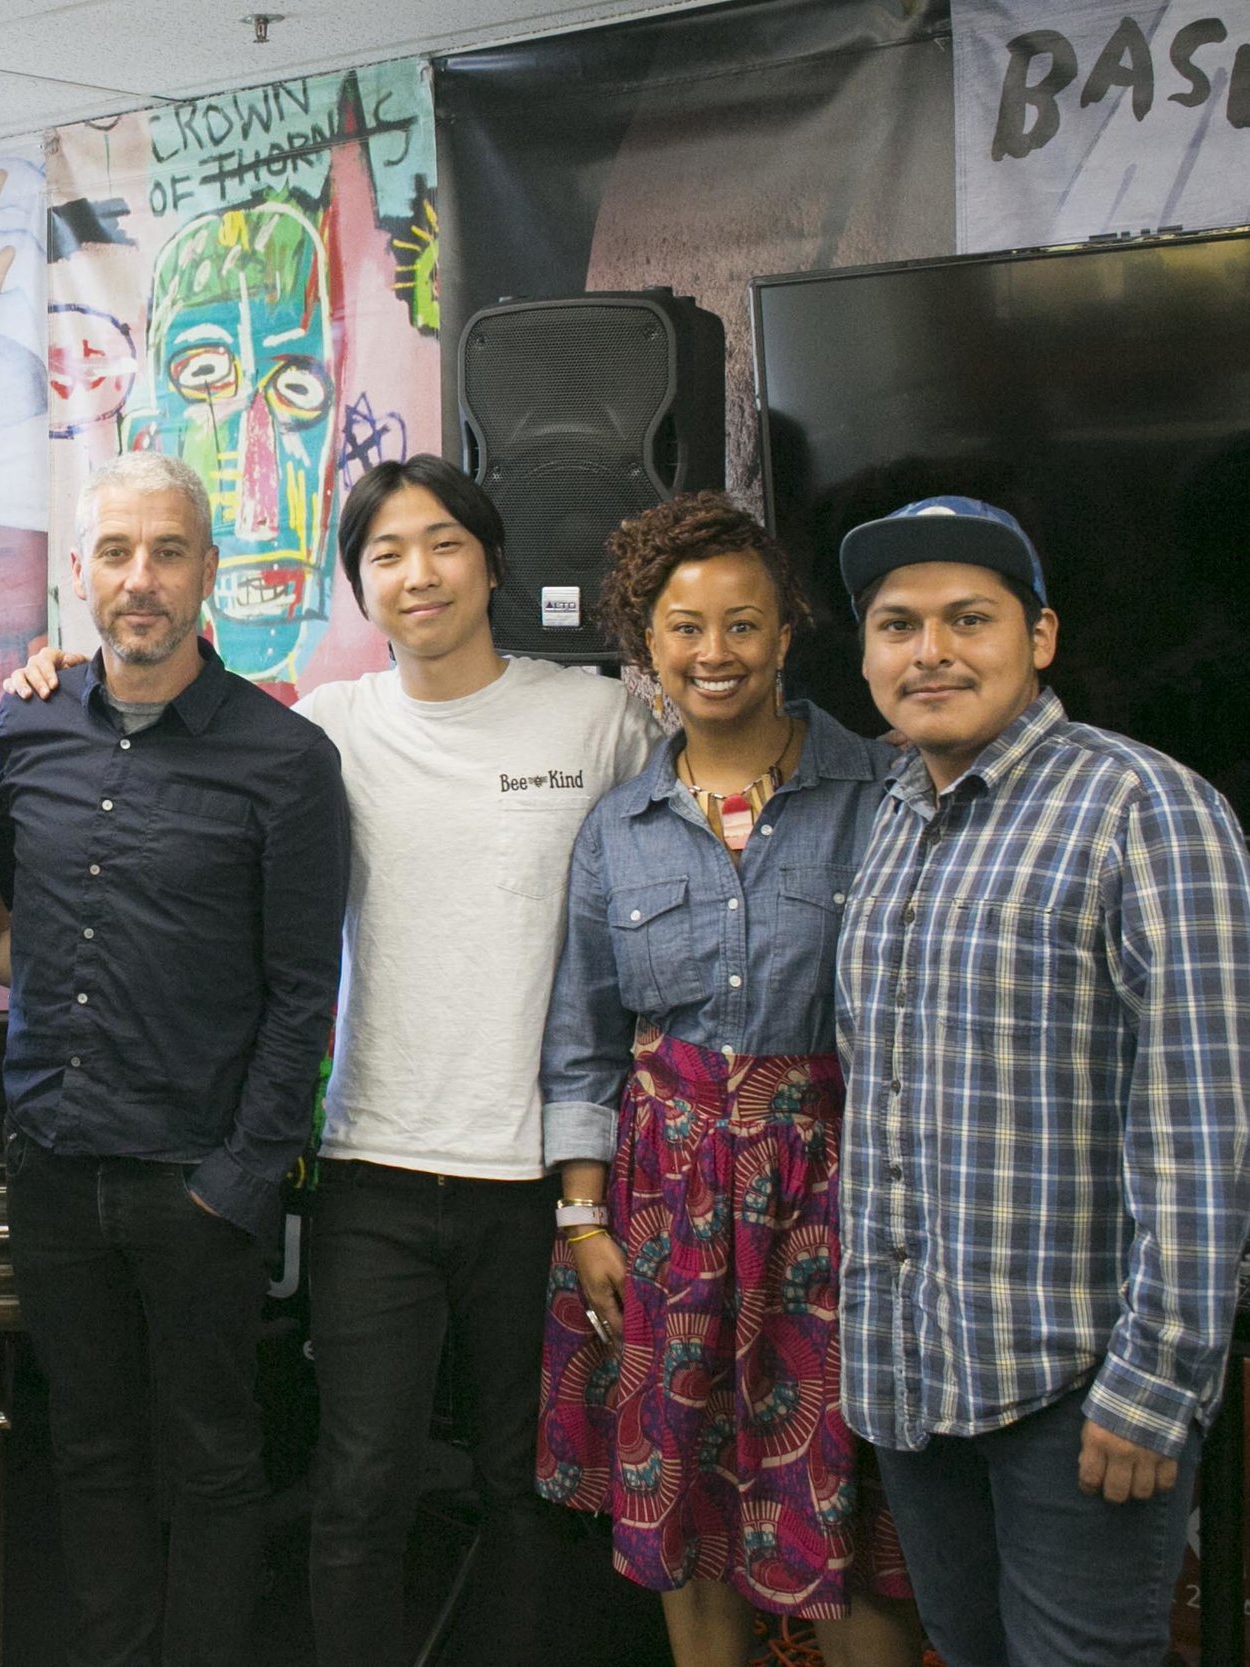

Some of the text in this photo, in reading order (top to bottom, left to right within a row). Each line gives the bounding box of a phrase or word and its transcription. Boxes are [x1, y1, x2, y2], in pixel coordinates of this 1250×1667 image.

[148, 80, 311, 164] CROWN
[148, 174, 195, 217] OF
[499, 769, 584, 793] Bee Kind
